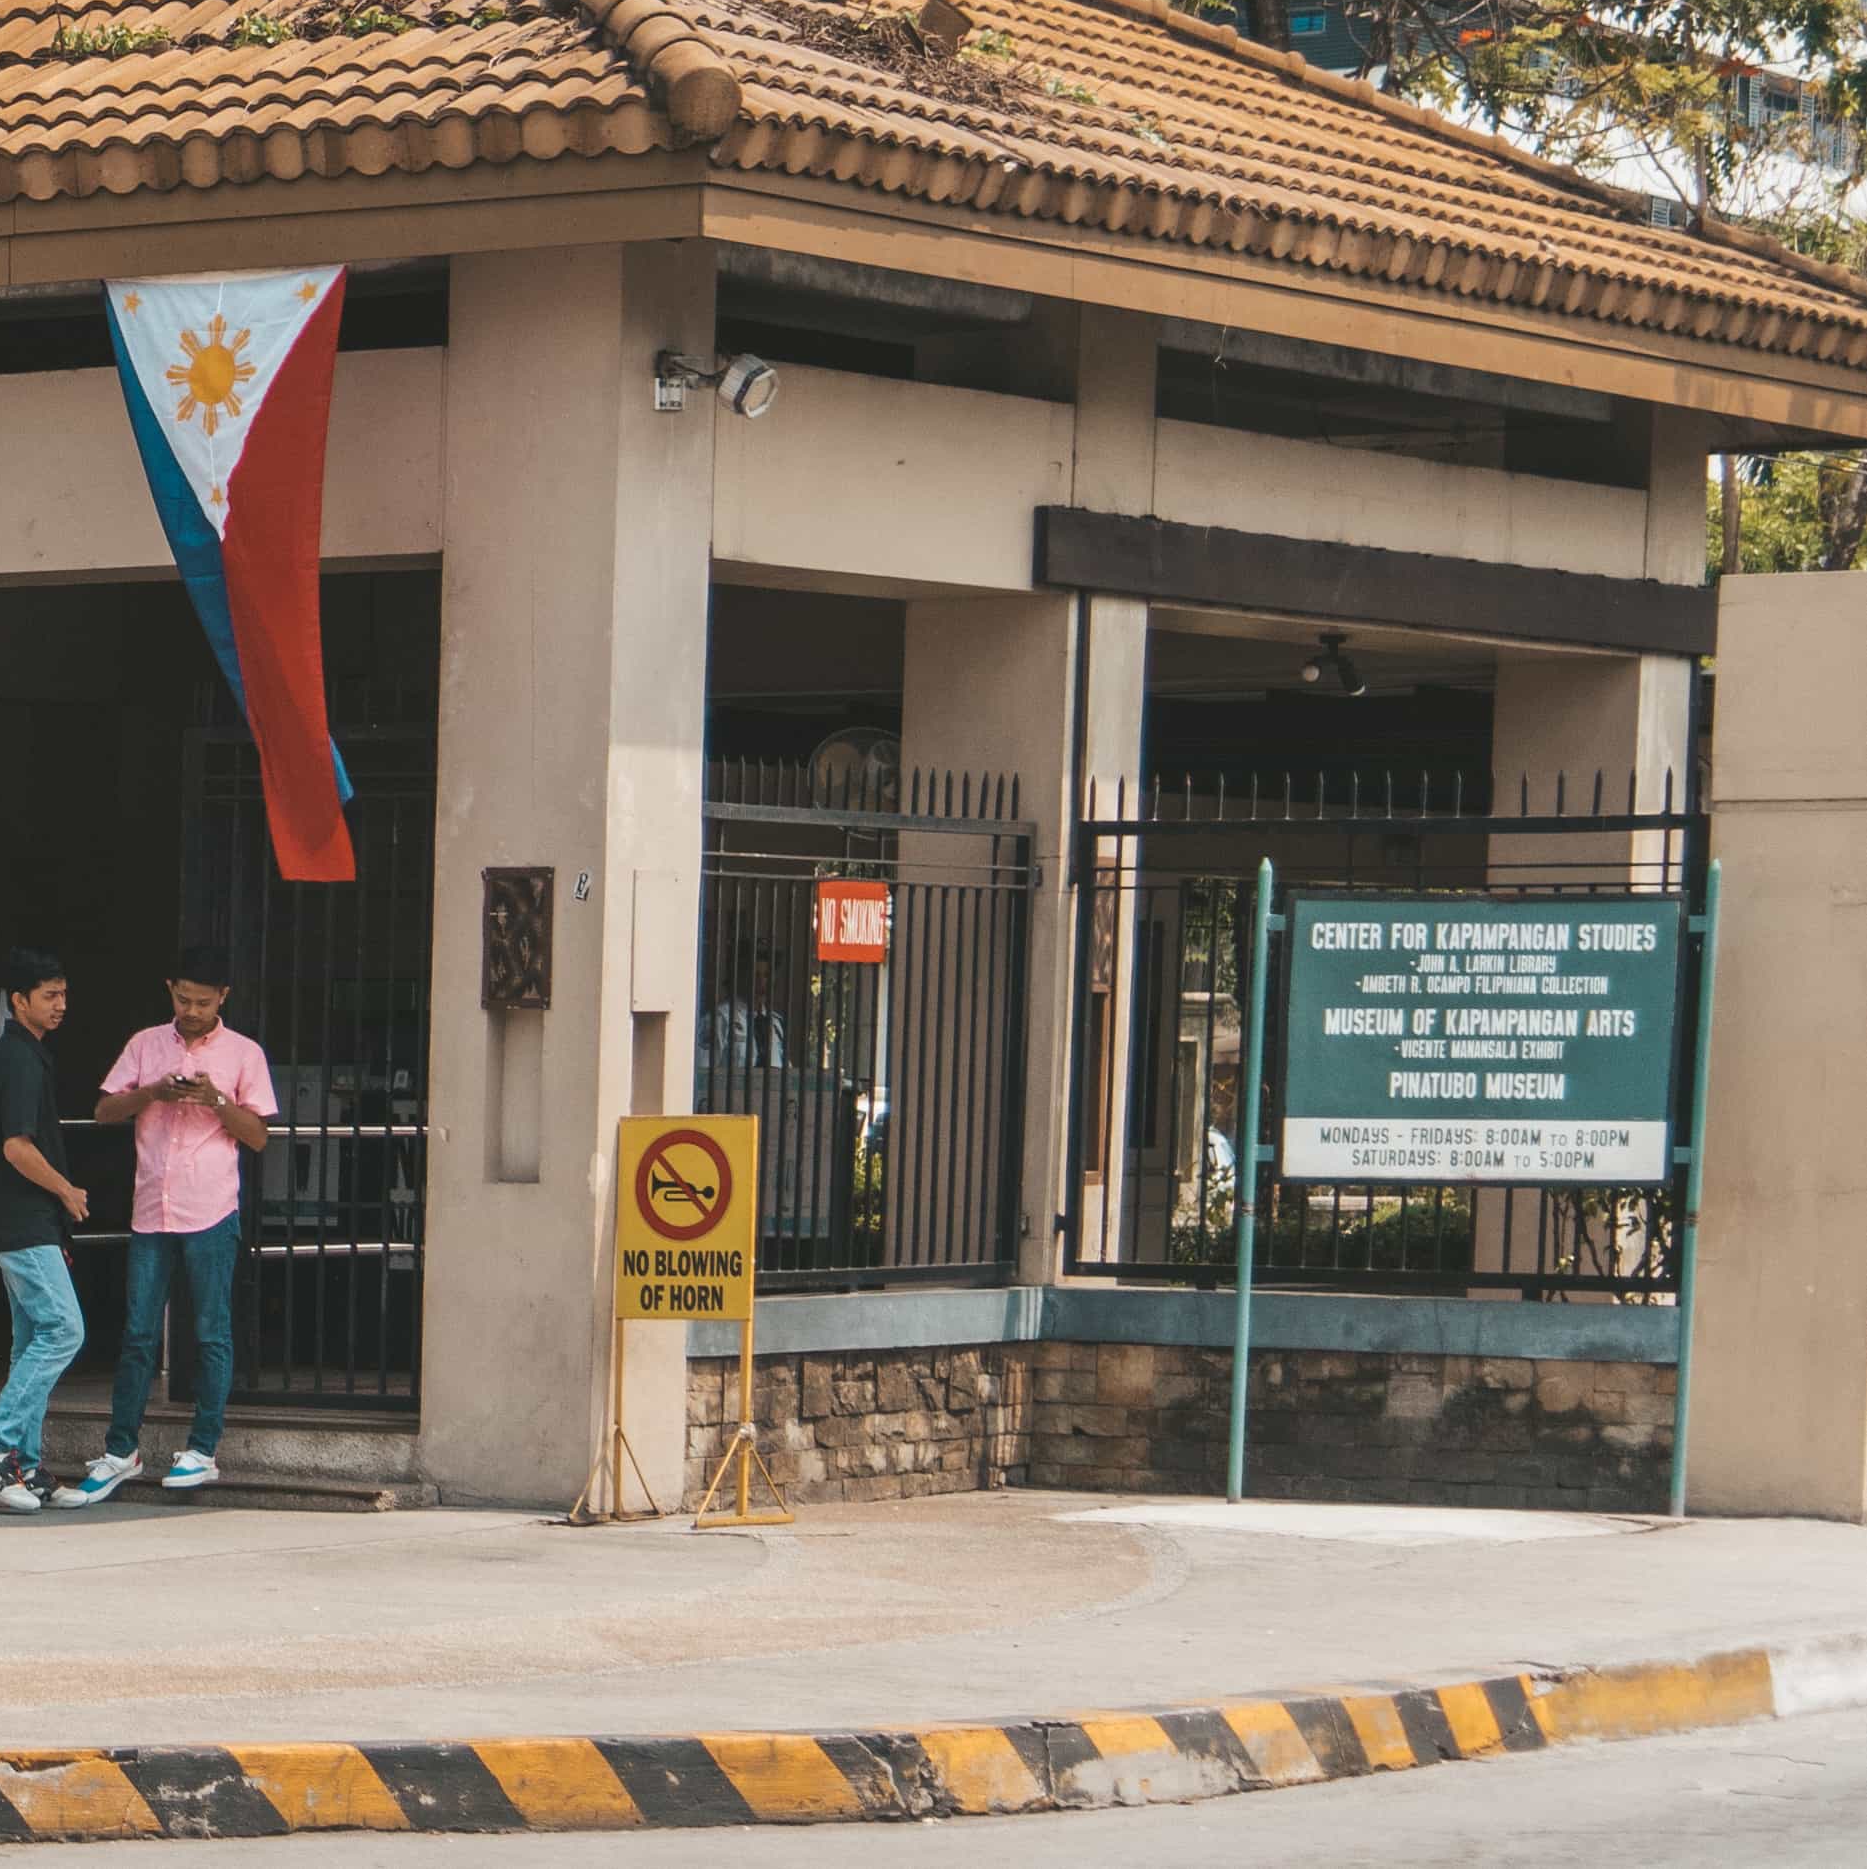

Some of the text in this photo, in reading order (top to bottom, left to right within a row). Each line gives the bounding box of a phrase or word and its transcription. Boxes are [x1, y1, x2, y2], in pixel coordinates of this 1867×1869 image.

[820, 897, 885, 945] NO SMOKING
[1312, 923, 1658, 951] CENTER FOR KAPAMPANGAN STUDIES
[1449, 955, 1460, 973] A.
[1466, 954, 1505, 973] LARKIN
[1509, 955, 1557, 974] LIBRARY
[1411, 976, 1422, 994] R.
[1427, 975, 1471, 994] OCAMPO
[1475, 976, 1537, 994] FILIPINIANA
[1541, 976, 1609, 995] COLLECTION
[1324, 1008, 1636, 1037] MUSEUM OF KAPAMPANGAN ARTS
[1451, 1039, 1516, 1059] MANANSALA
[1522, 1040, 1565, 1060] EXHIBIT
[1388, 1072, 1564, 1101] PINATUBO MUSEUM
[1319, 1127, 1390, 1145] MONDAYS
[1410, 1128, 1478, 1145] FRIDAYS:
[1485, 1129, 1542, 1147] 8:00AM
[1575, 1130, 1630, 1148] 8:00PM
[1351, 1150, 1441, 1167] SATURDAYS:
[1449, 1150, 1505, 1168] 8:00AM
[1539, 1151, 1595, 1169] 5:00PM
[623, 1249, 743, 1277] NO BLOWING
[640, 1284, 724, 1311] OF HORN
